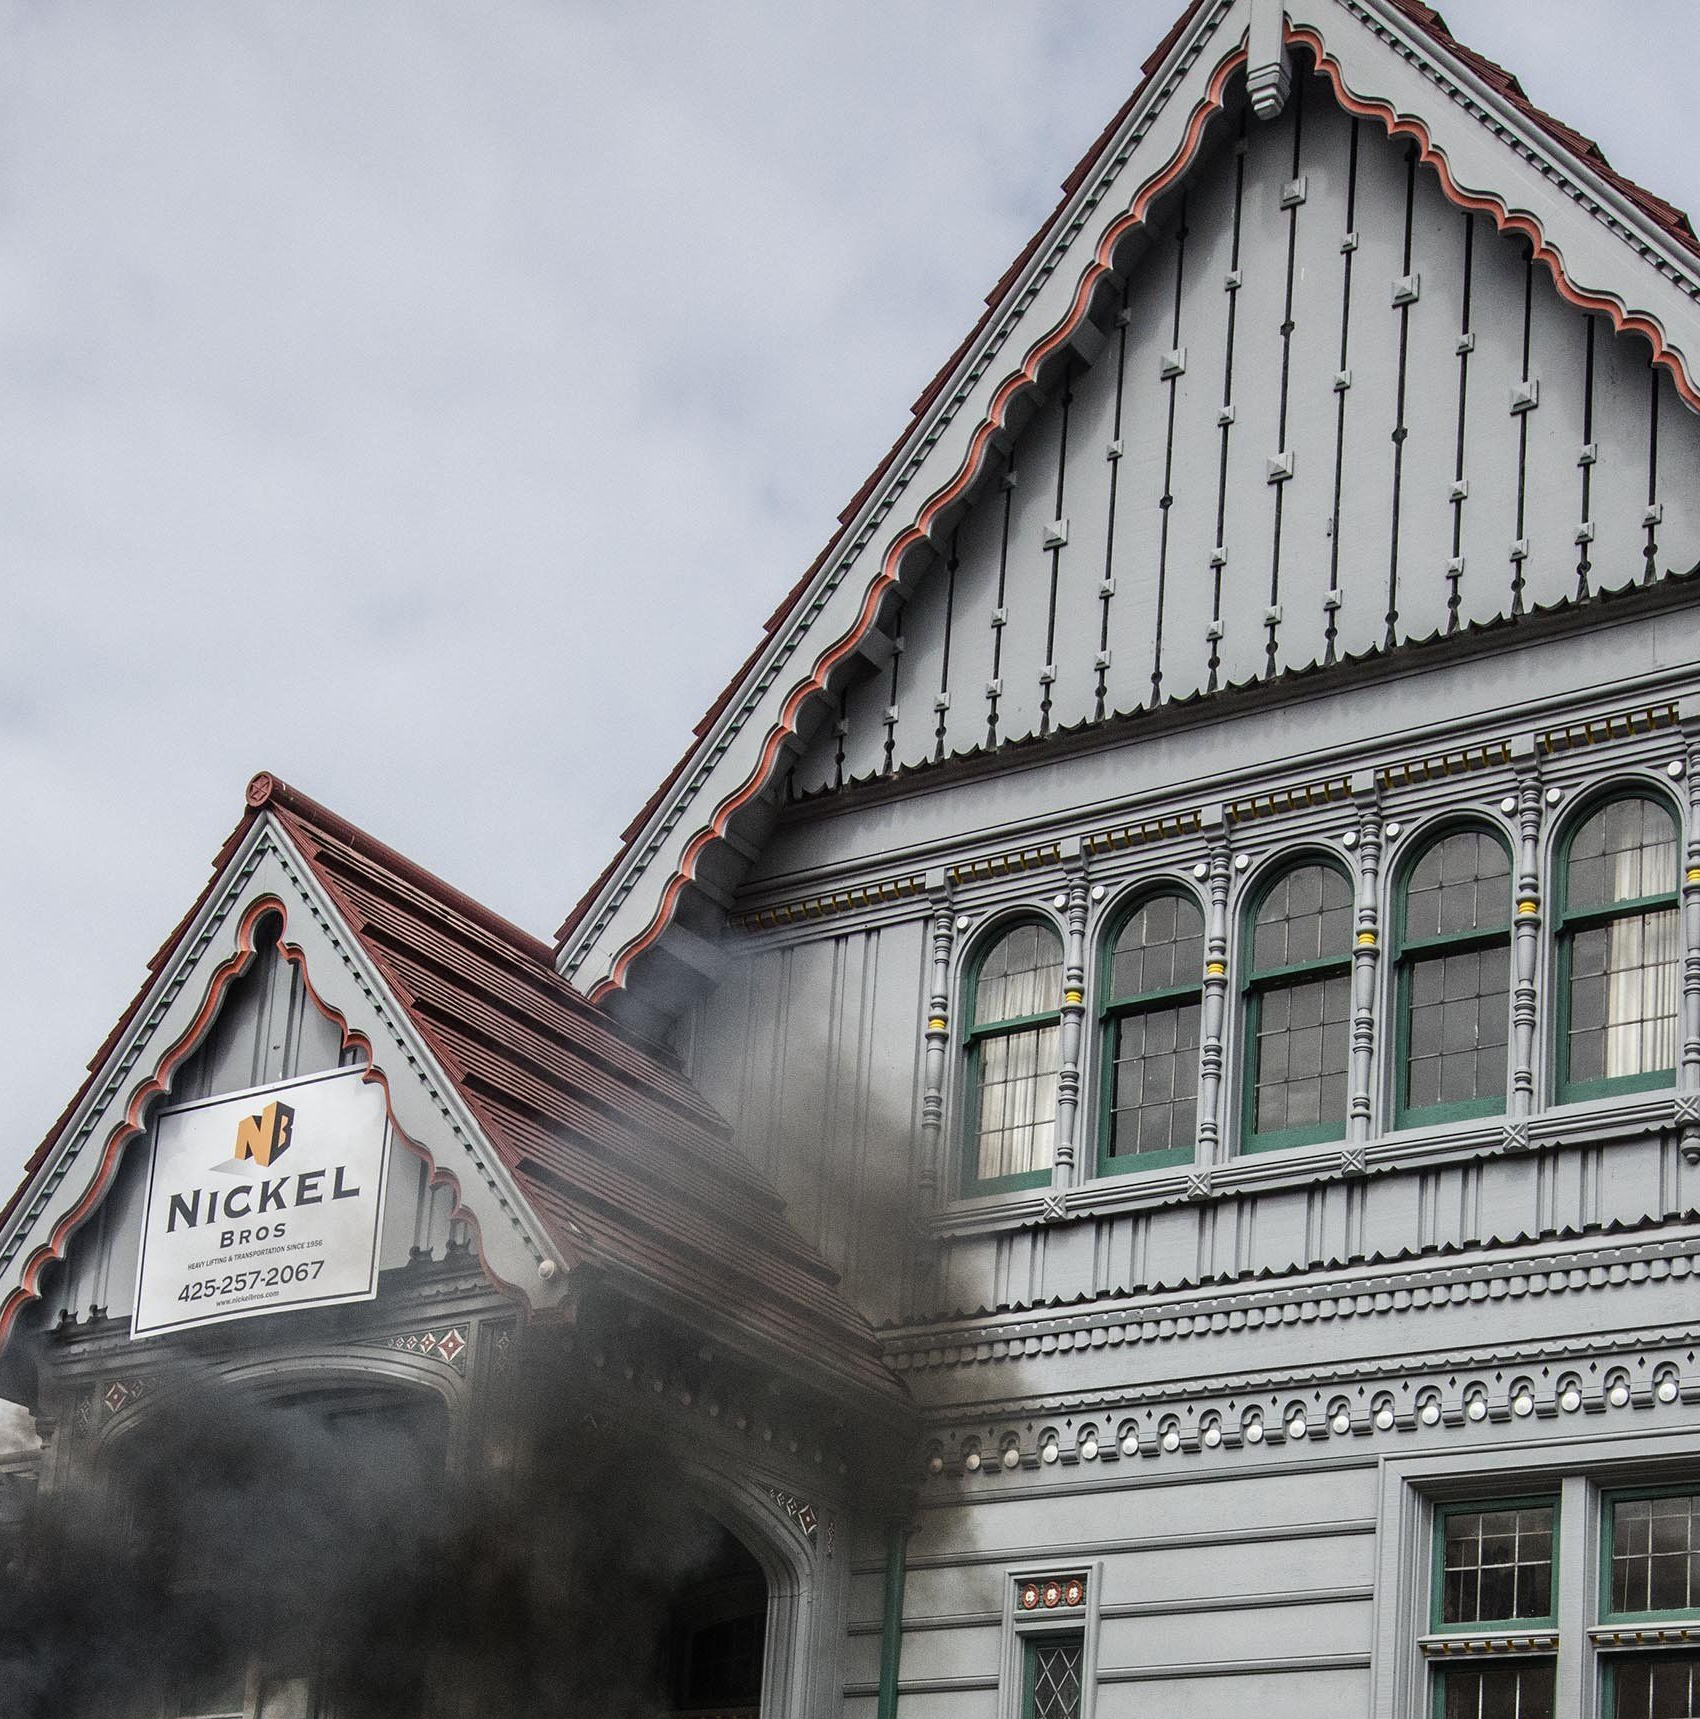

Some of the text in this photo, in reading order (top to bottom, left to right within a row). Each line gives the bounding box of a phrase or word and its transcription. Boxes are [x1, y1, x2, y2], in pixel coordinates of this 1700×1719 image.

[166, 1166, 360, 1233] NICKEL
[220, 1223, 286, 1249] BROS
[188, 1260, 205, 1271] HEAVY
[206, 1256, 227, 1267] LIFTING
[234, 1246, 285, 1261] TRANSPORTATION
[286, 1242, 306, 1252] SINCE
[306, 1239, 323, 1249] 1956
[178, 1260, 325, 1302] 425-257-2067
[216, 1290, 279, 1307] www.nickelbros.com
